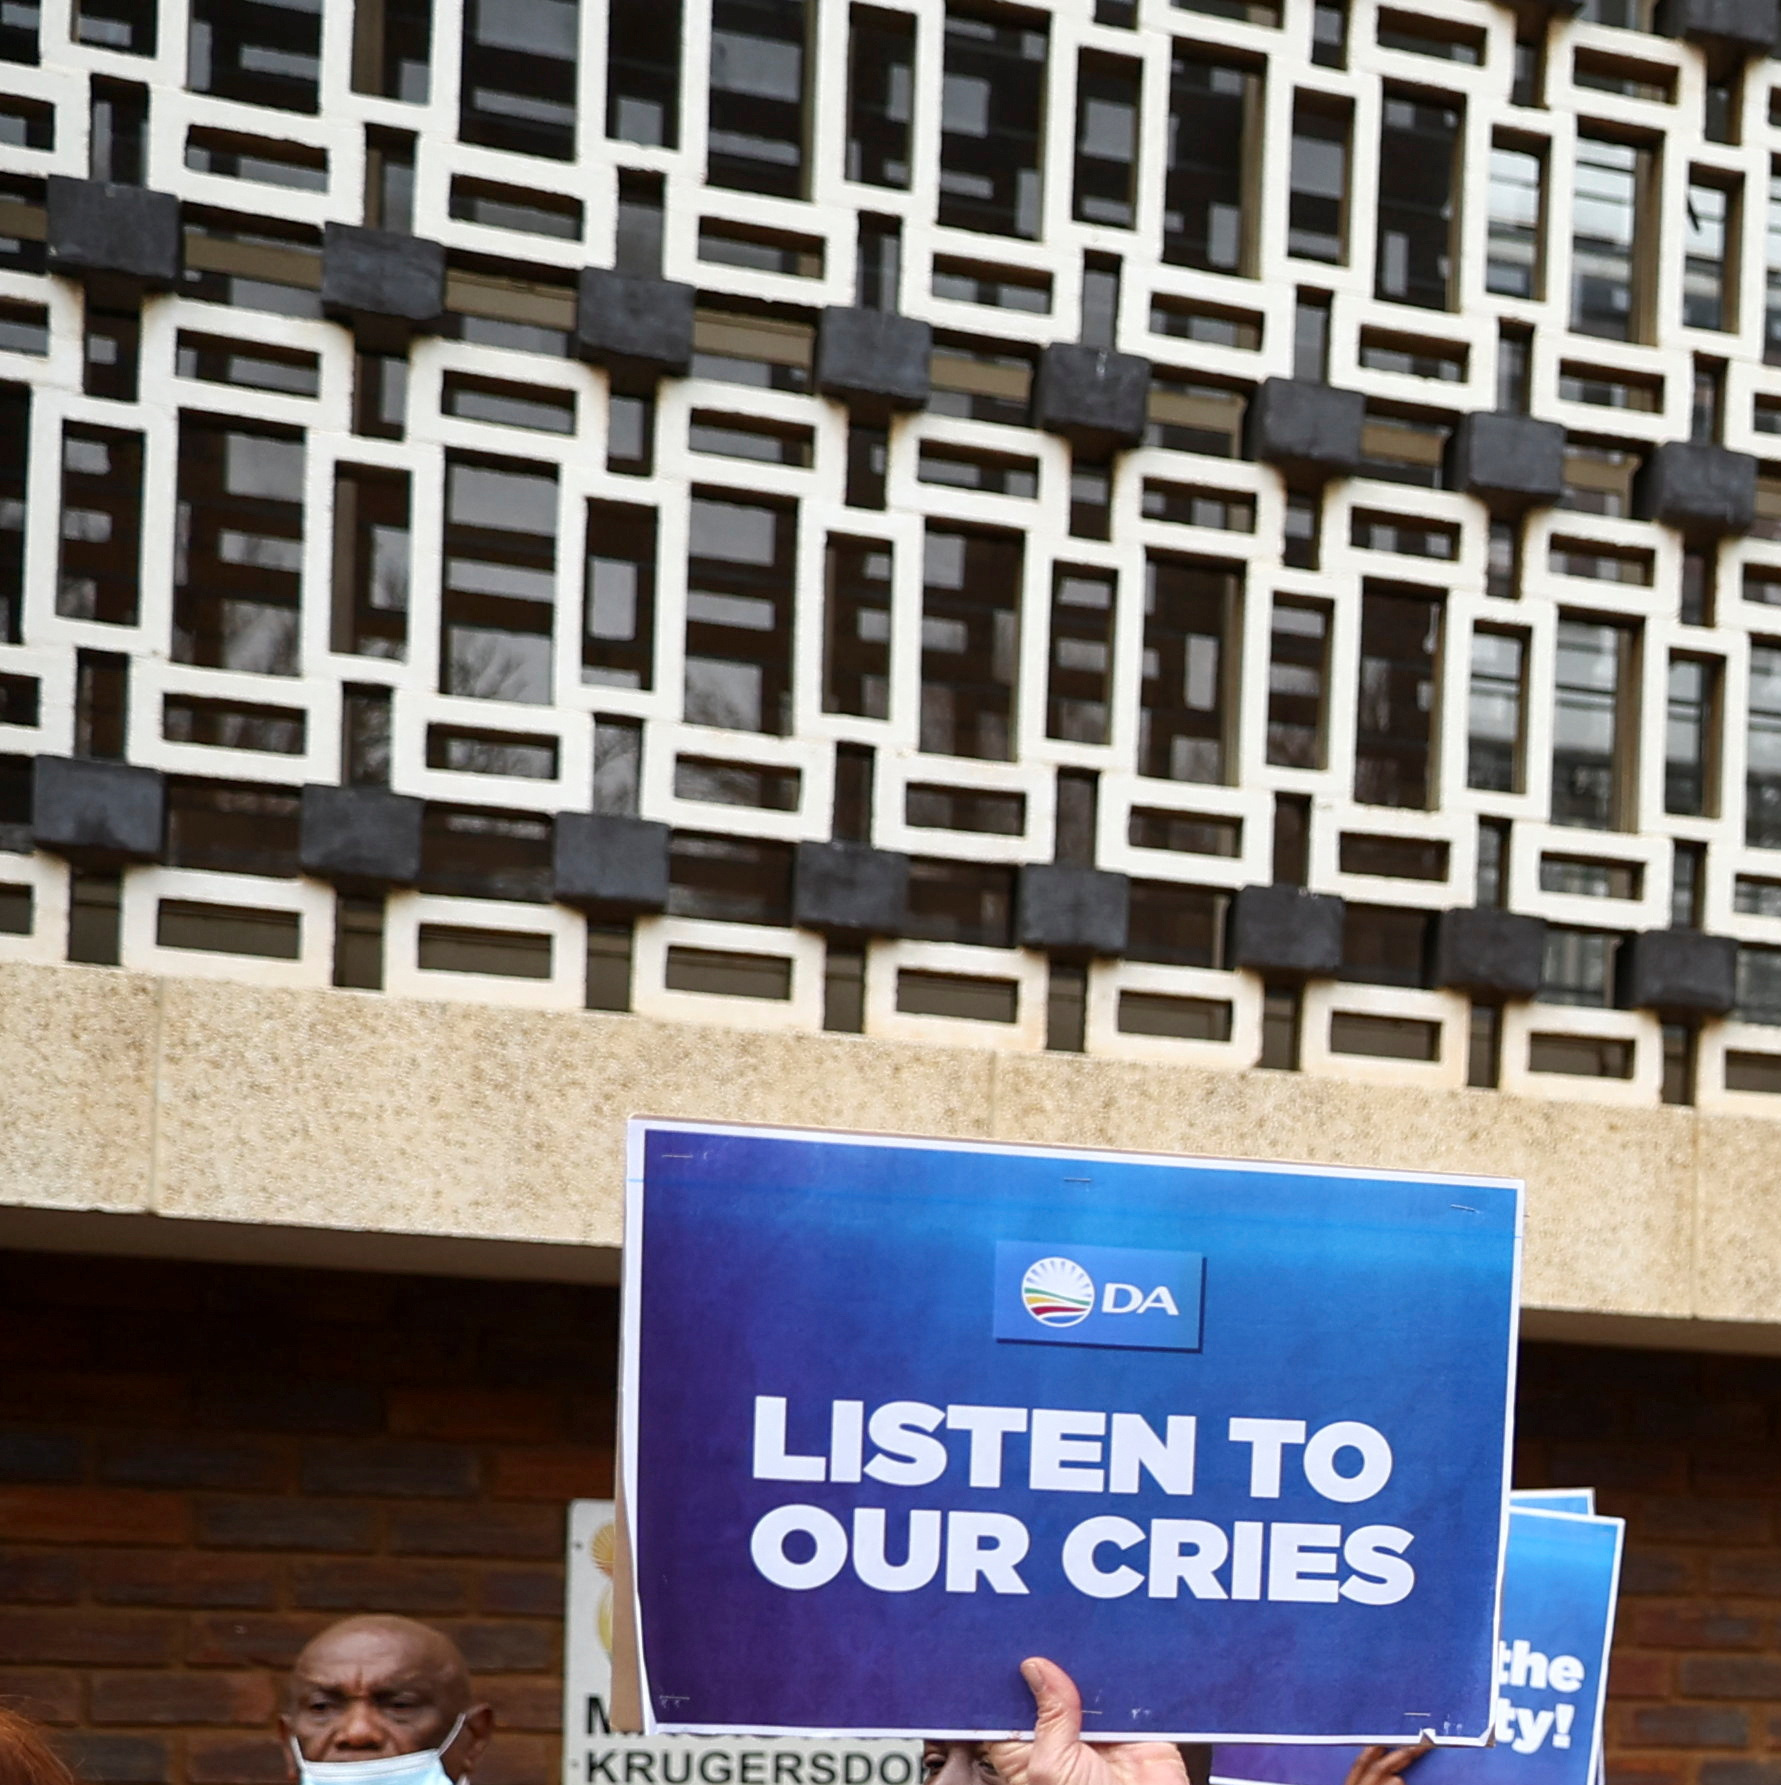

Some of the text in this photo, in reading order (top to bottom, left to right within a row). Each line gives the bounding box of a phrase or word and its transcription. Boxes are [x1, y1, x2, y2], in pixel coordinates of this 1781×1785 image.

[1101, 1282, 1179, 1316] DA
[752, 1394, 1394, 1503] LISTEN TO
[750, 1503, 1416, 1606] OUR CRIES
